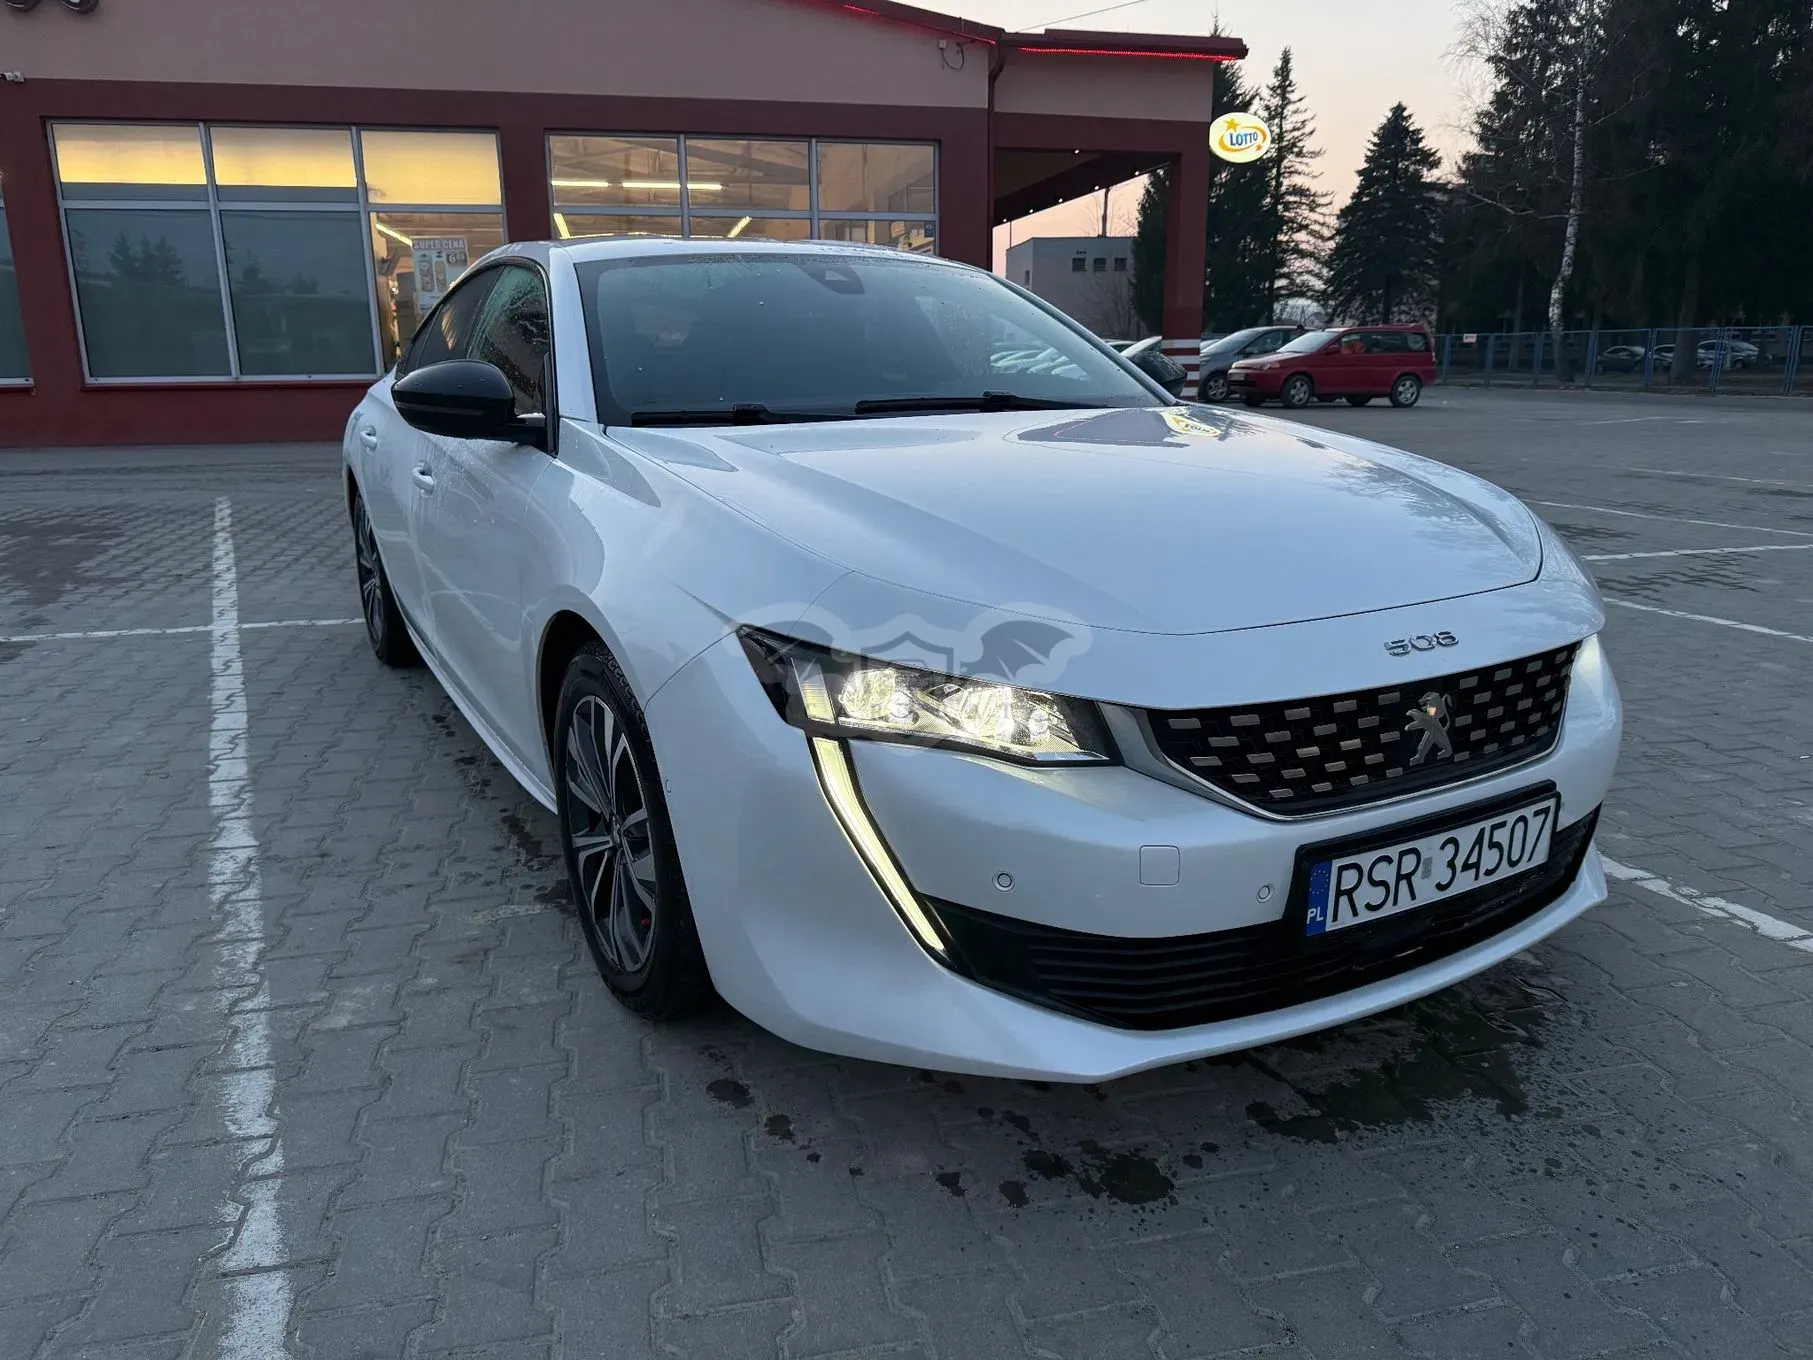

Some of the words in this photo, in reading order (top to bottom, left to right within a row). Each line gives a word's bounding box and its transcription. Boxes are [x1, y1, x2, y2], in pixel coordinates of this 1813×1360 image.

[1229, 131, 1259, 147] LOTTO
[1331, 847, 1422, 923] RSR
[1434, 805, 1551, 892] 34507
[1307, 907, 1324, 924] PL
